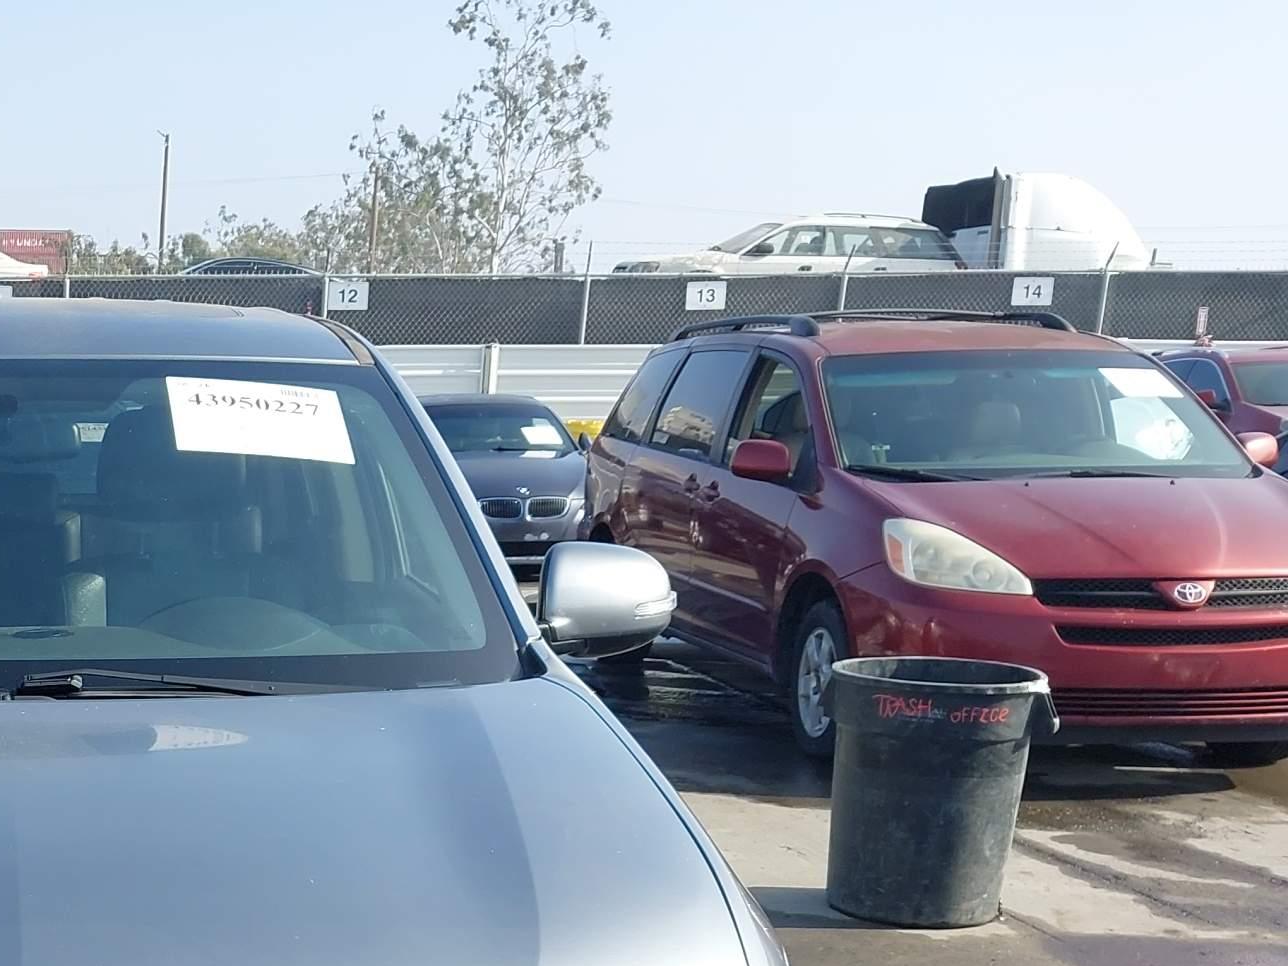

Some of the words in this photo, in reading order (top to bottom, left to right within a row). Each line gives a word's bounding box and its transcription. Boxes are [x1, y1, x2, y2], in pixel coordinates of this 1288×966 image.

[338, 289, 358, 303] 12
[697, 289, 715, 303] 13
[1024, 284, 1043, 299] 14
[188, 393, 318, 416] 43950227
[872, 694, 932, 718] TRASH
